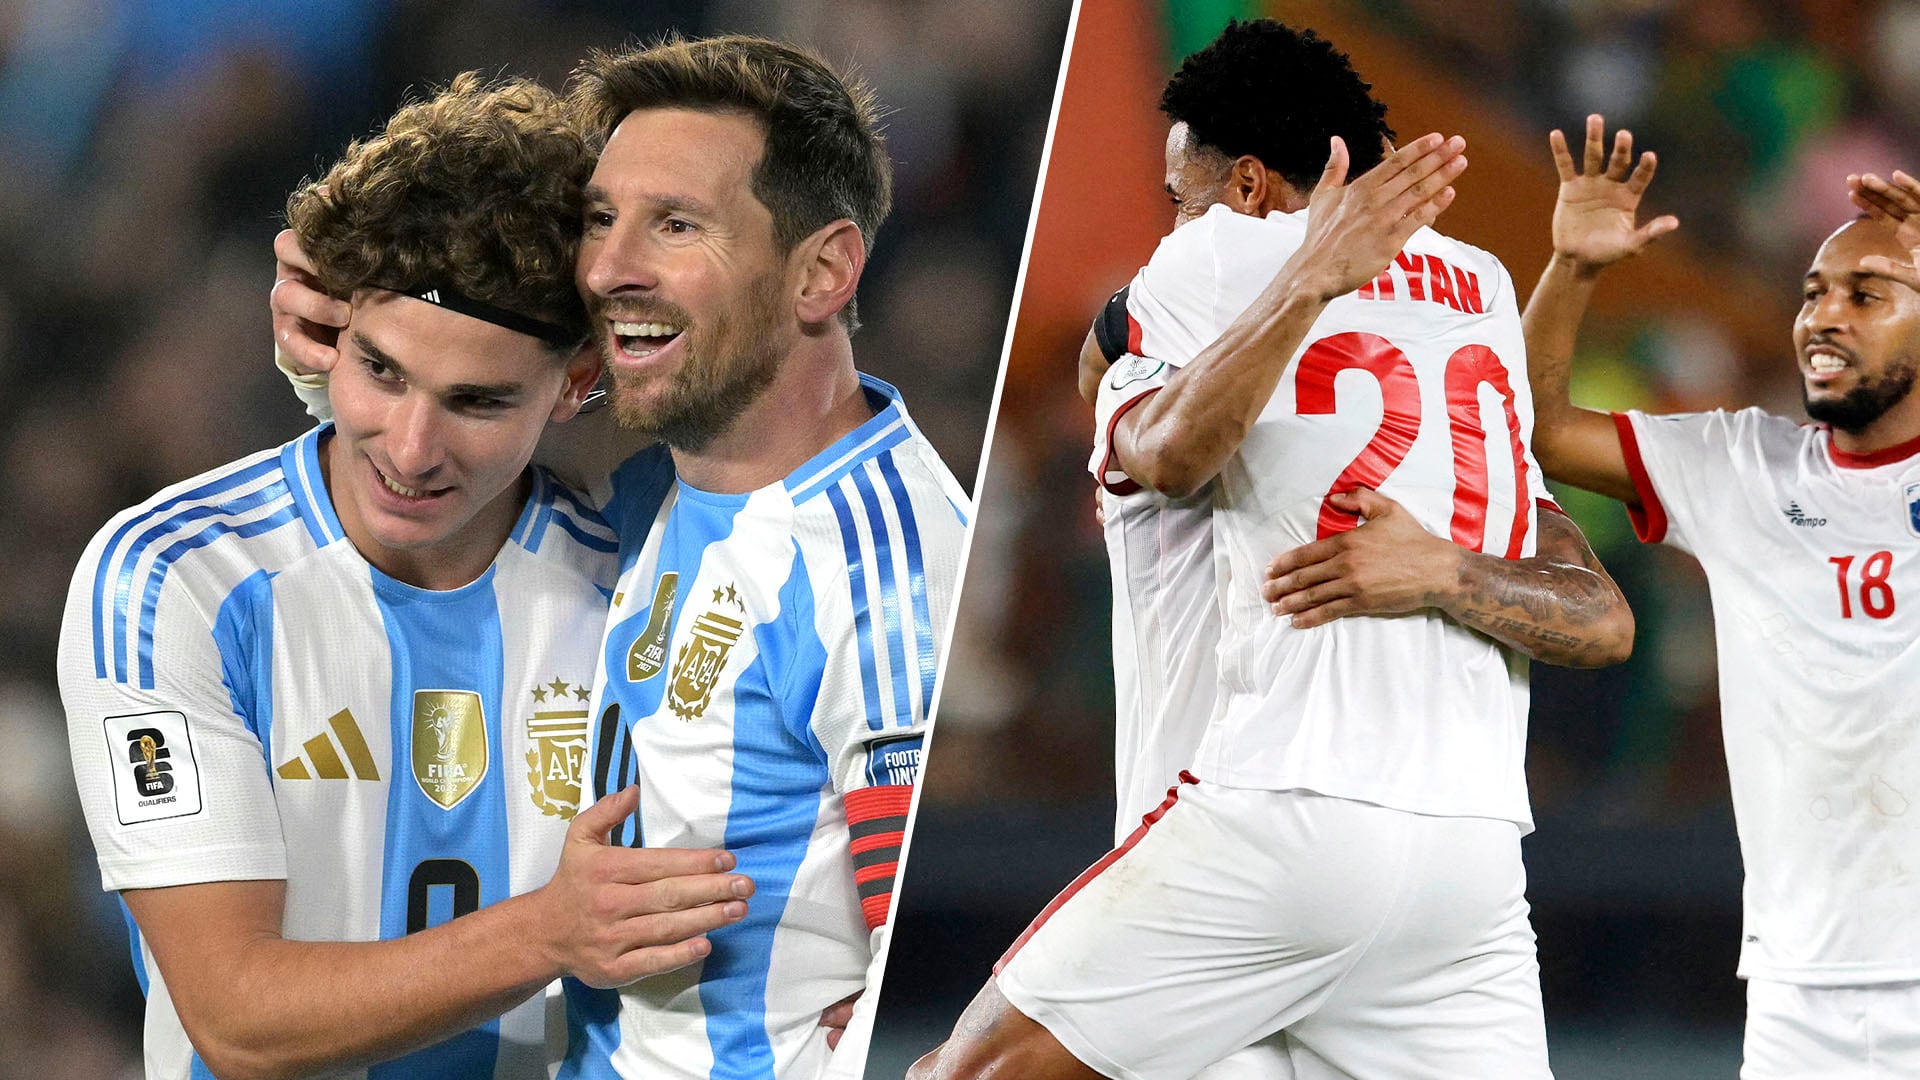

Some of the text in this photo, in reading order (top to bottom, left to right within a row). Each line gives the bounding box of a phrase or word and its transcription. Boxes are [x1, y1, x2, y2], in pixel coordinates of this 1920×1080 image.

[1295, 332, 1530, 560] 20
[1827, 550, 1896, 620] 18
[643, 644, 662, 661] FIFA
[682, 640, 722, 690] AFA
[428, 763, 465, 778] FIFA
[145, 781, 164, 791] FIFA
[138, 796, 176, 807] QUALIFIERS
